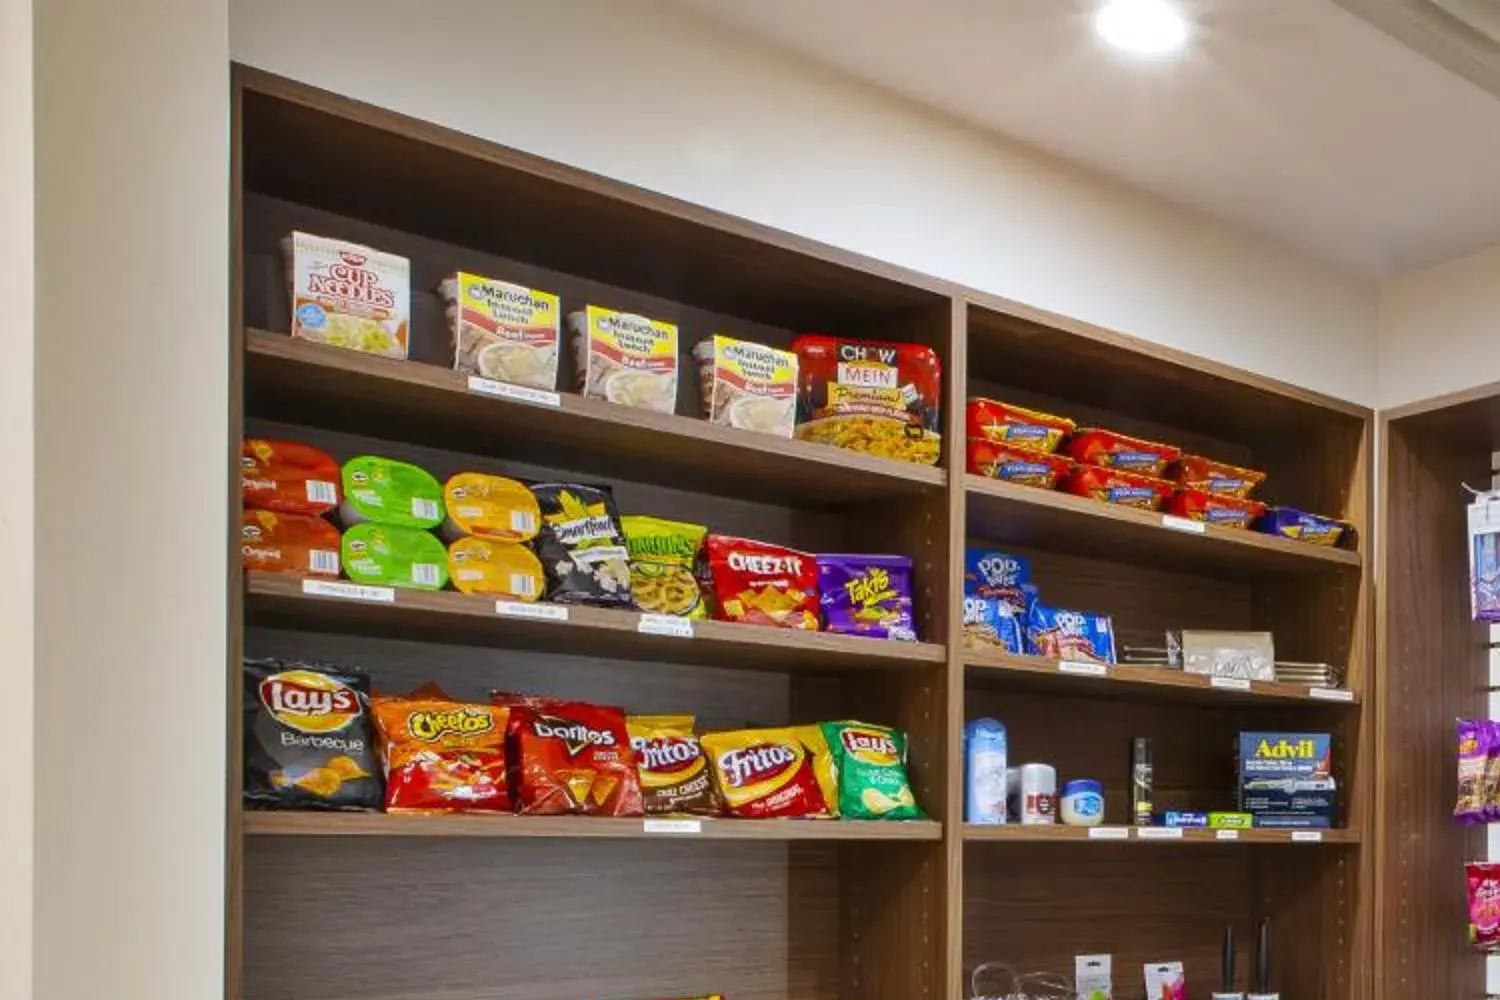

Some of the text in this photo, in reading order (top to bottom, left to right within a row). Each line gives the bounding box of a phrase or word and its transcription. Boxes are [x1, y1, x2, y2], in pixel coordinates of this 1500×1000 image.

[330, 264, 377, 287] CUP
[308, 273, 394, 308] NOODLES
[481, 284, 550, 311] Maruchan
[608, 316, 669, 341] Maruchan
[733, 346, 789, 368] Maruchan
[845, 368, 890, 383] MEIN
[412, 711, 490, 741] Cheetos
[535, 720, 616, 746] Doritos
[281, 732, 364, 751] Barbecue
[630, 735, 701, 769] Fritos
[1256, 739, 1315, 759] Advil
[717, 742, 796, 788] Fritos
